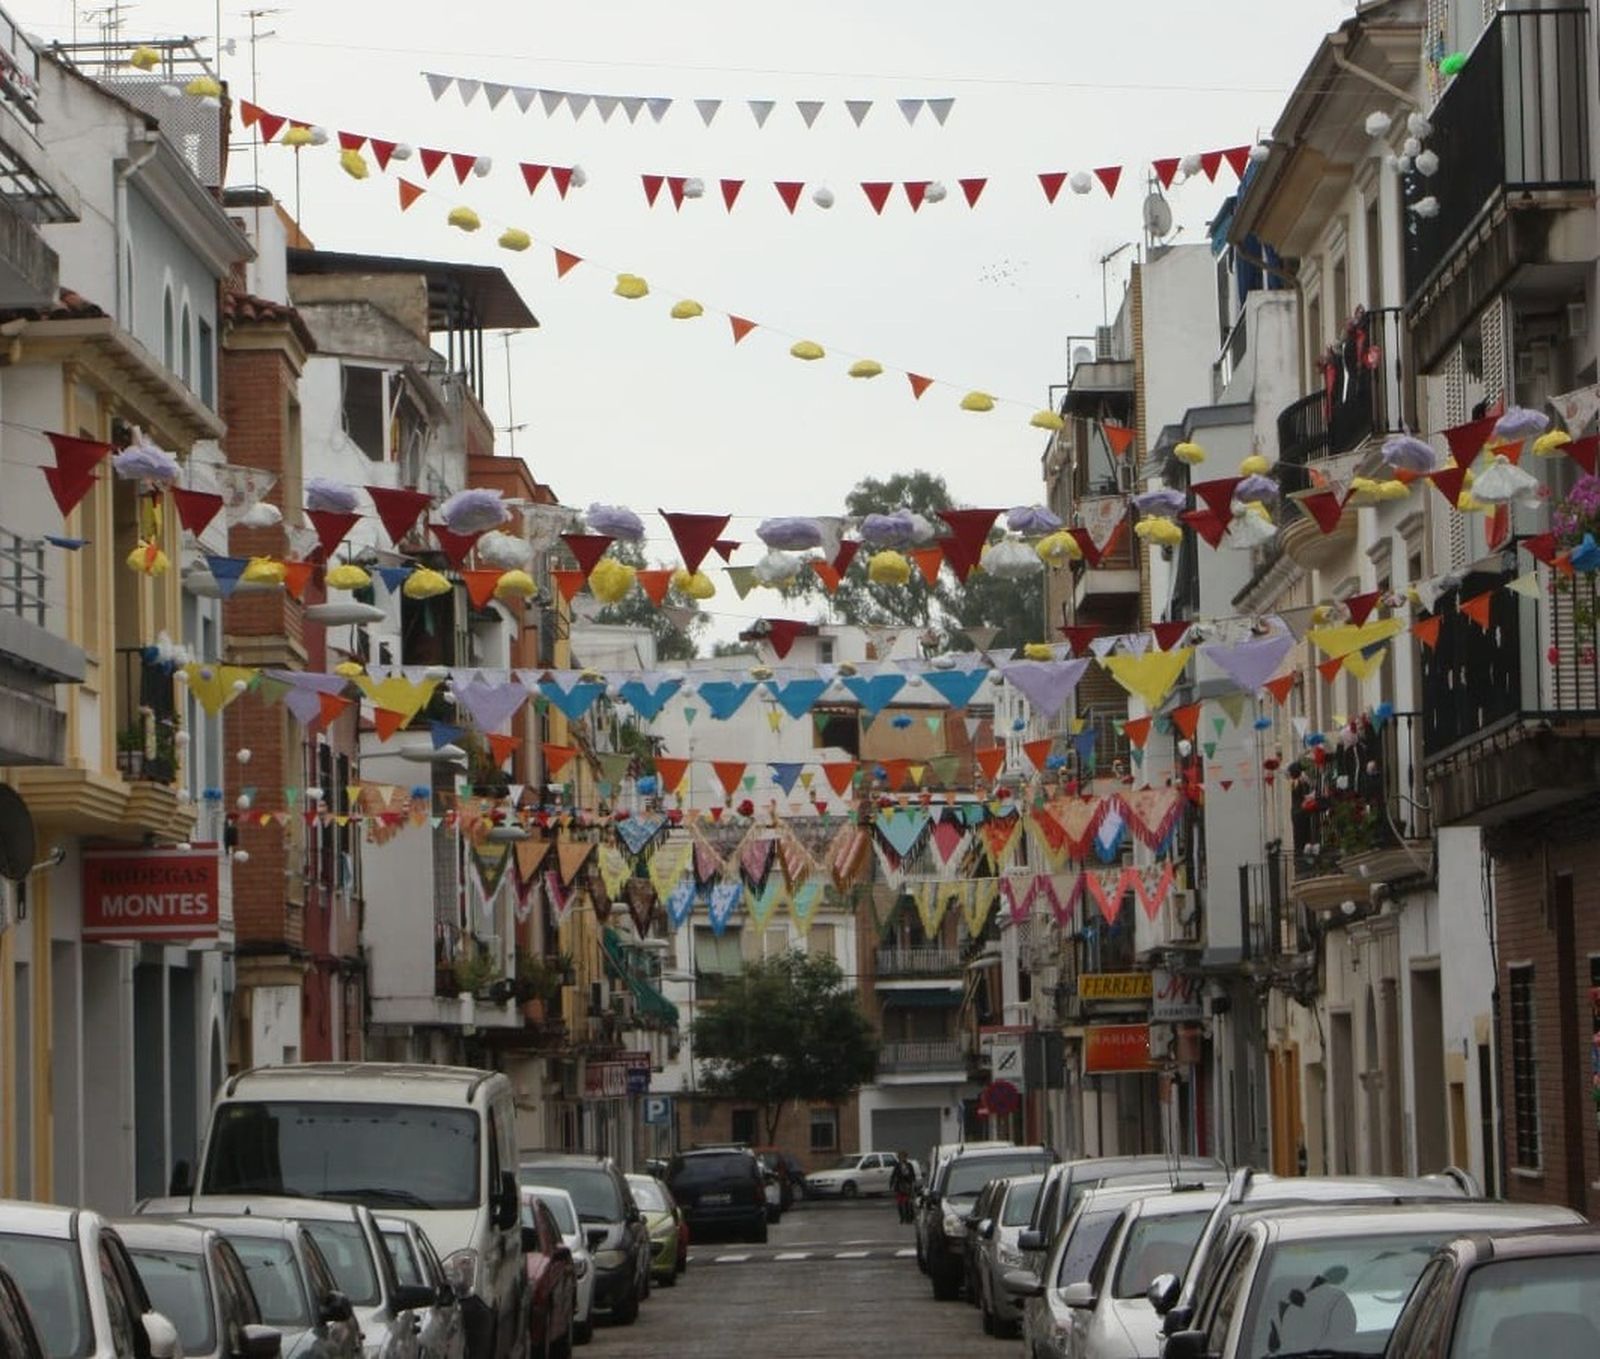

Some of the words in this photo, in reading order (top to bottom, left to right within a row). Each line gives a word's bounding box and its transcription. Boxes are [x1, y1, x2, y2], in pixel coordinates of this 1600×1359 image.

[101, 865, 208, 885] BODEGAS
[101, 893, 209, 917] MONTES
[647, 1100, 665, 1122] P
